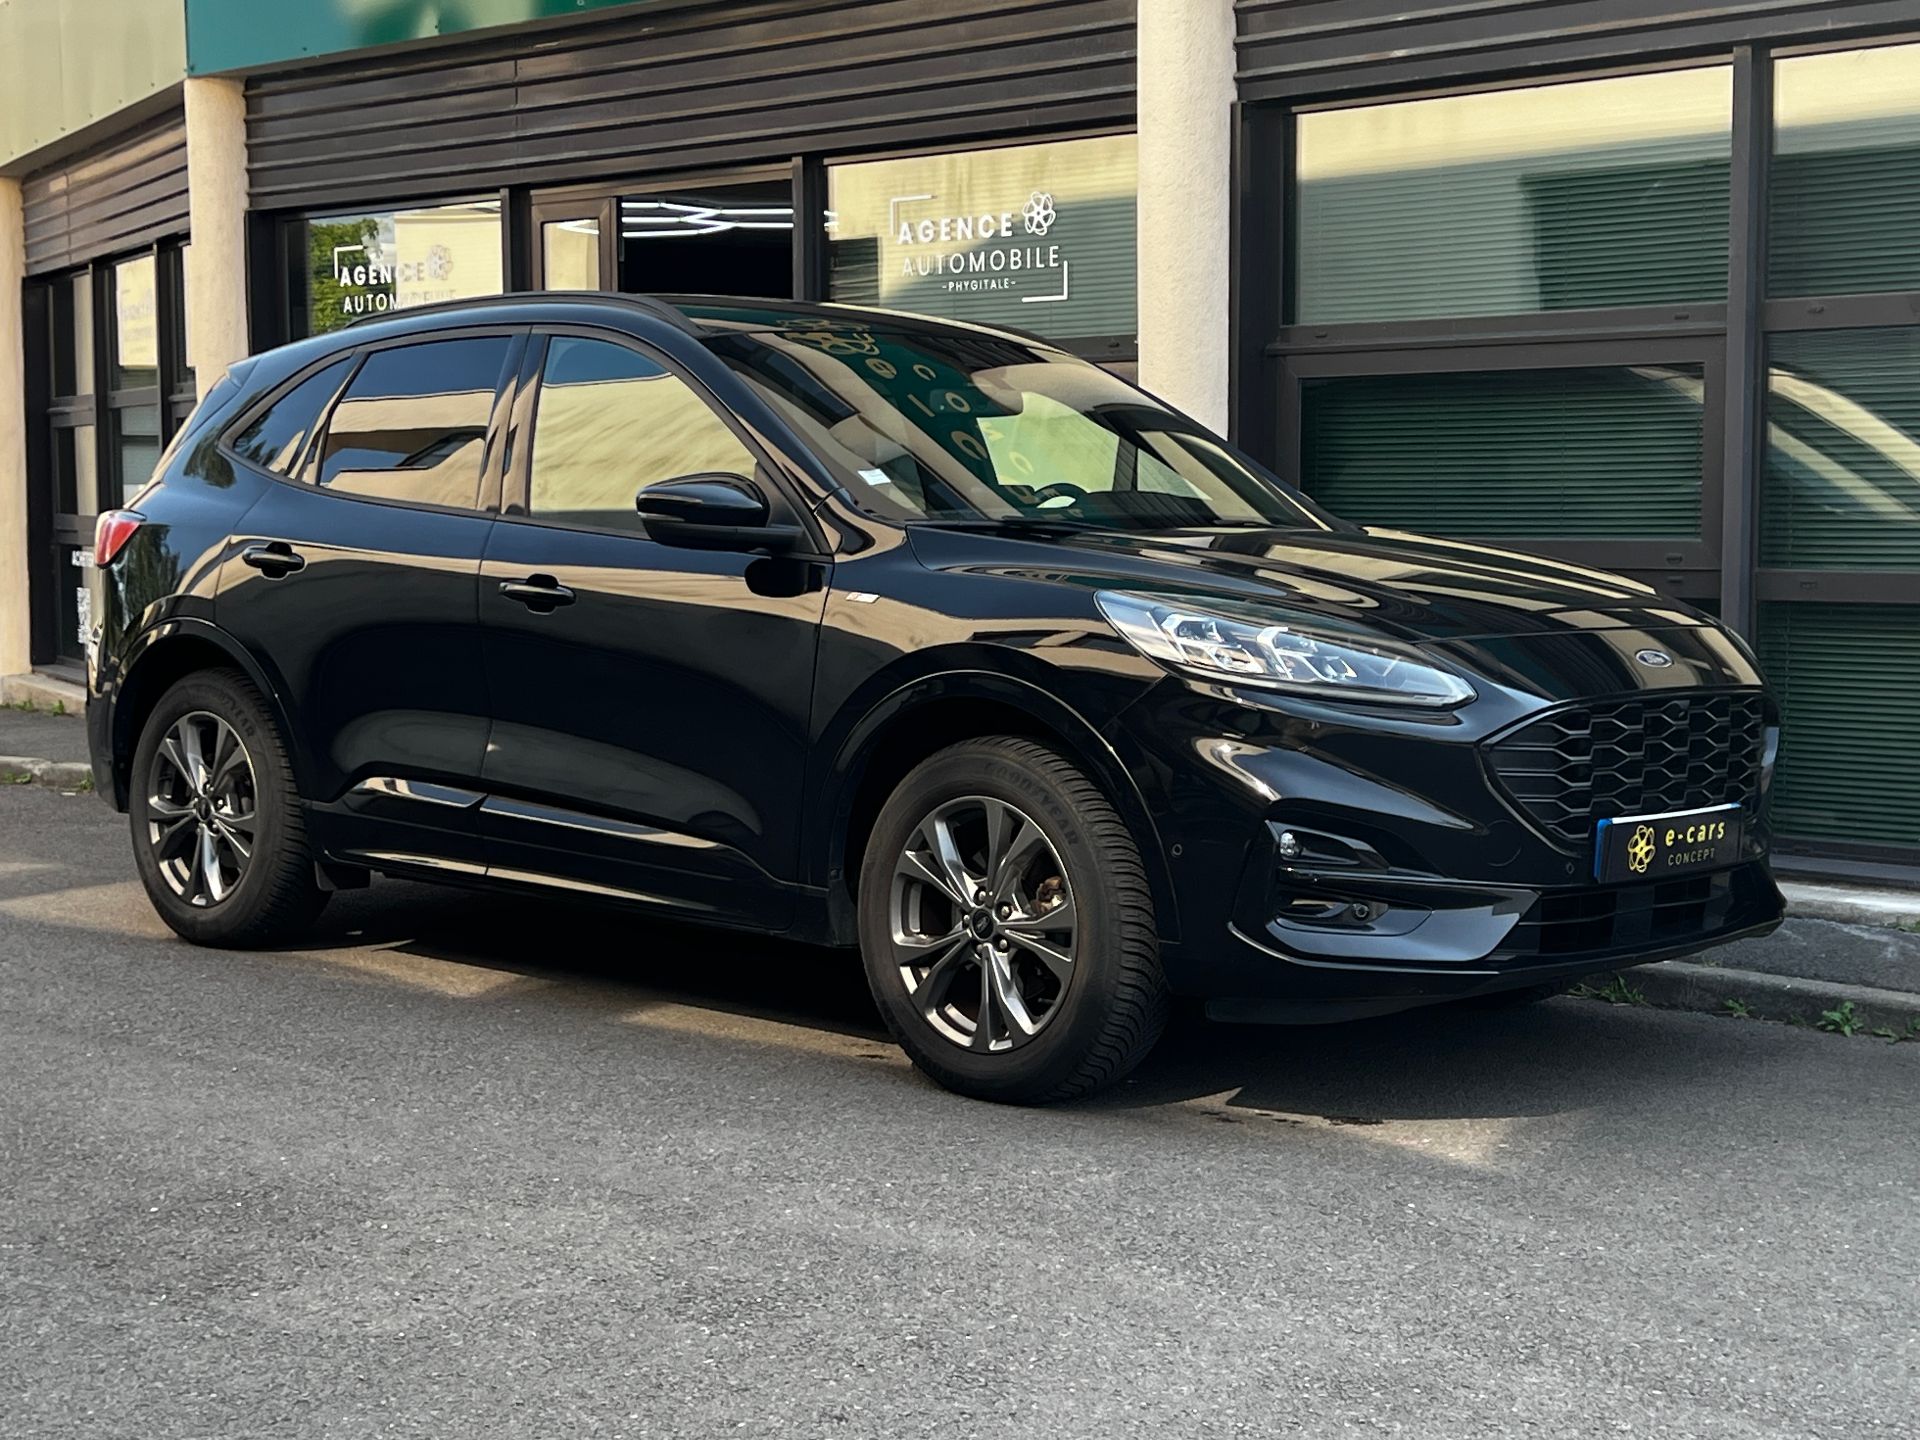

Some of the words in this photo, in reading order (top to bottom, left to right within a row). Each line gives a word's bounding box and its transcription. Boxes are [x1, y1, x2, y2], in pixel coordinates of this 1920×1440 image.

[897, 212, 1013, 245] AGENCE
[902, 245, 1059, 276] AUTOMOBILE
[1665, 821, 1725, 847] e-cars
[1667, 847, 1716, 866] CONCEPT
